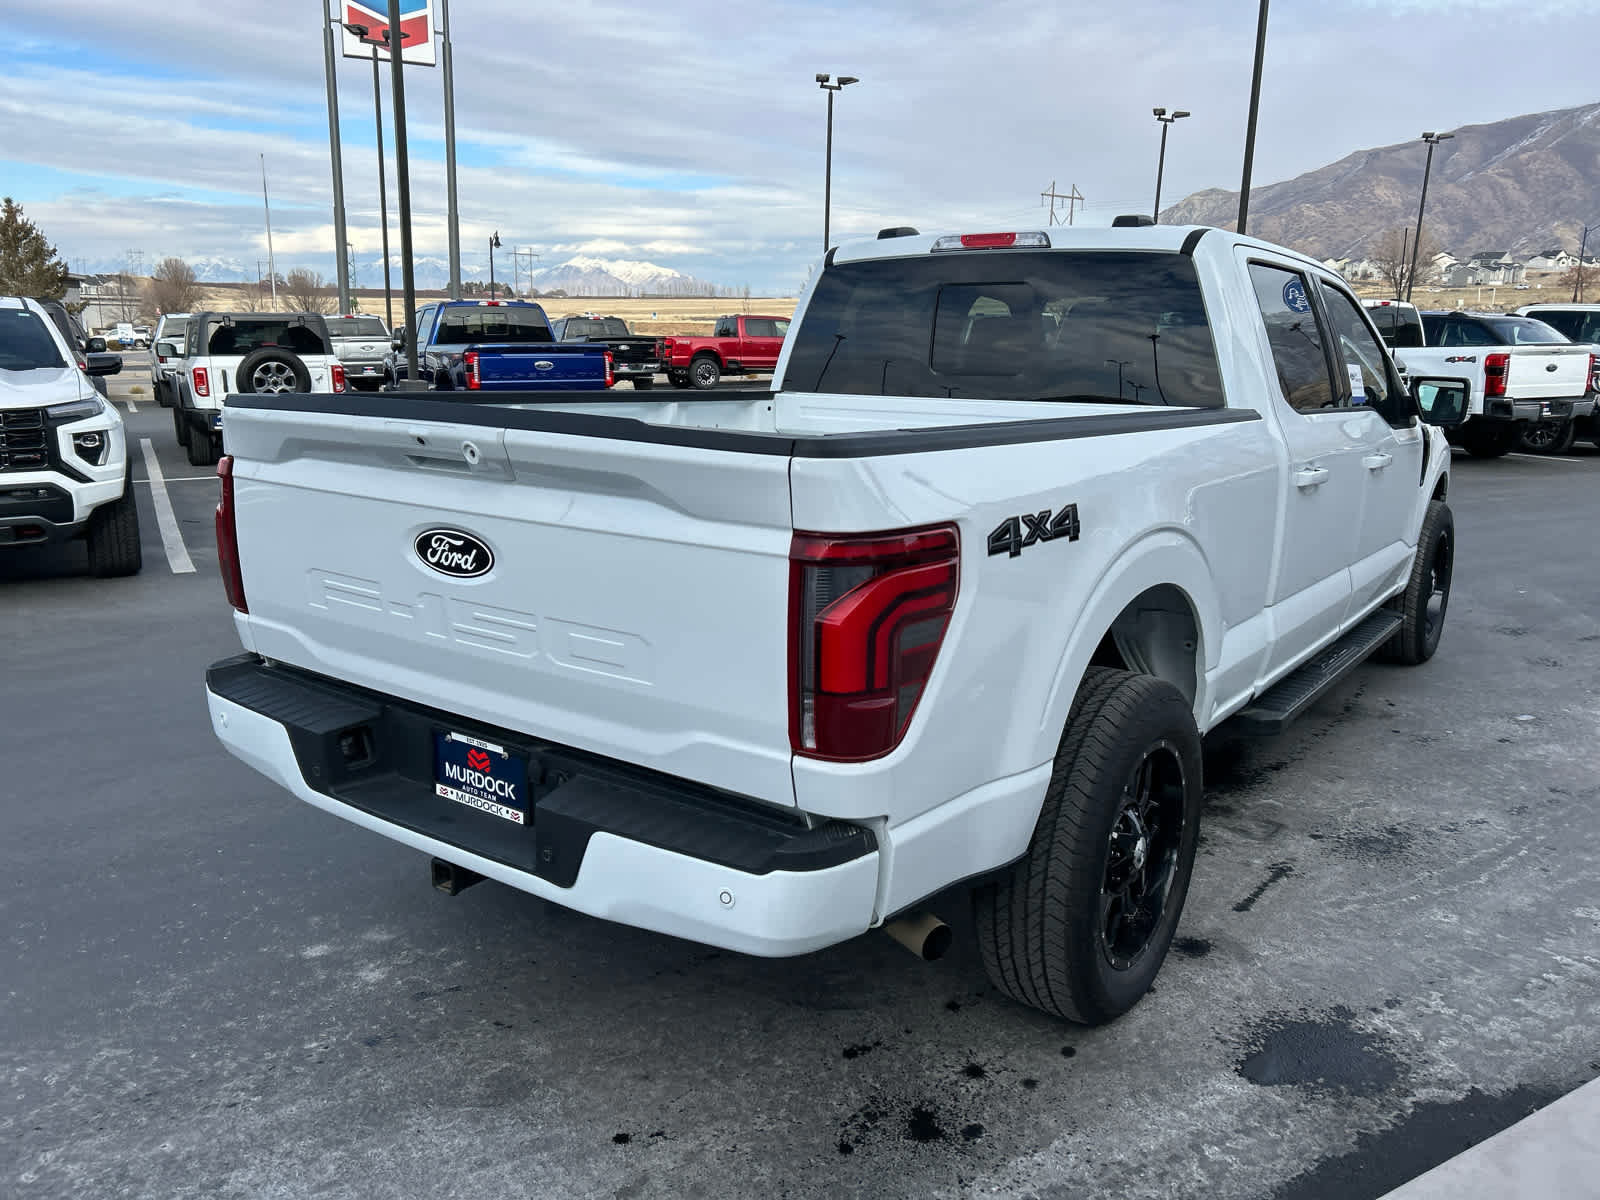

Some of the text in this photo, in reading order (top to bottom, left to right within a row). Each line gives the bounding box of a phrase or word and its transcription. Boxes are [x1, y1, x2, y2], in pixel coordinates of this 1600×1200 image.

[427, 534, 477, 571] Ford
[305, 567, 654, 686] F-150
[445, 761, 516, 800] MURDOCK
[462, 785, 497, 802] AUTO TEAM
[455, 791, 503, 816] MURDOCK
